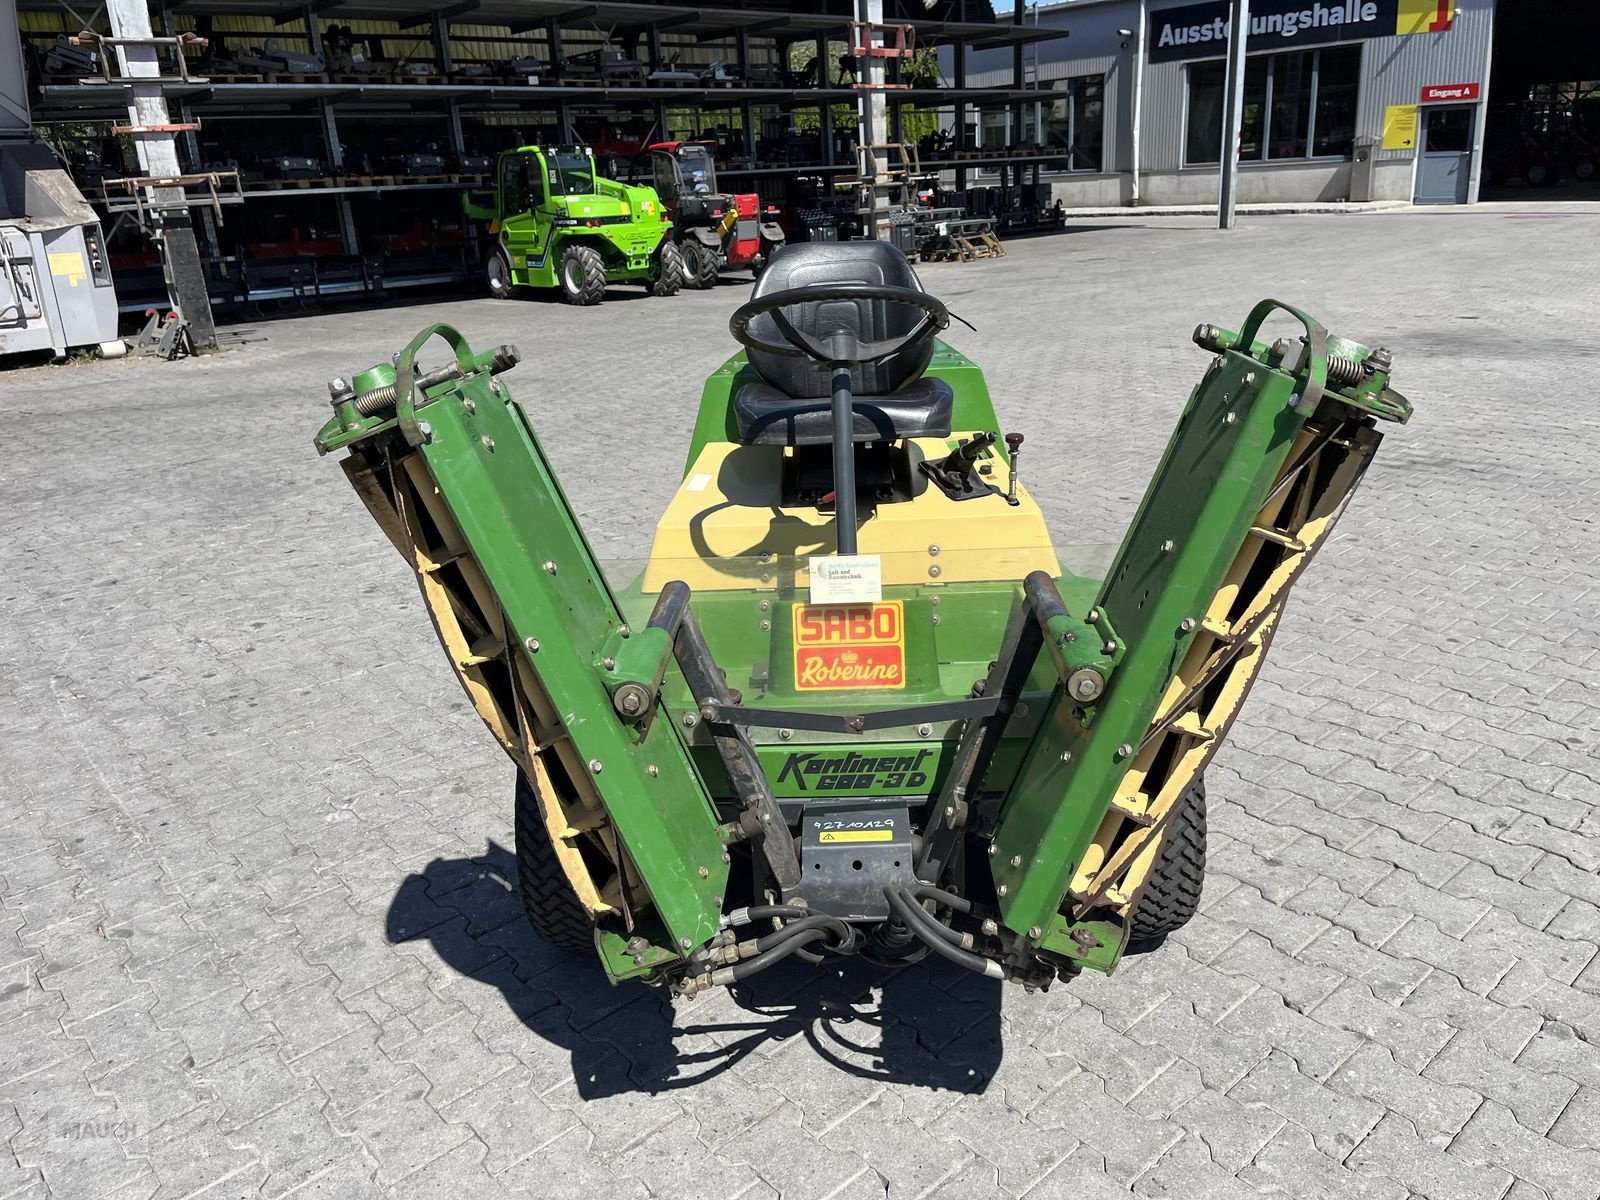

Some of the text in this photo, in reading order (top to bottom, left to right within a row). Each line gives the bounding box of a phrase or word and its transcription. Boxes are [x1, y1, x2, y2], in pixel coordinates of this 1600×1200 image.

[1429, 87, 1470, 98] Eingang A
[801, 608, 895, 641] SABO
[801, 656, 899, 686] Roberine
[776, 749, 933, 790] Kontinent
